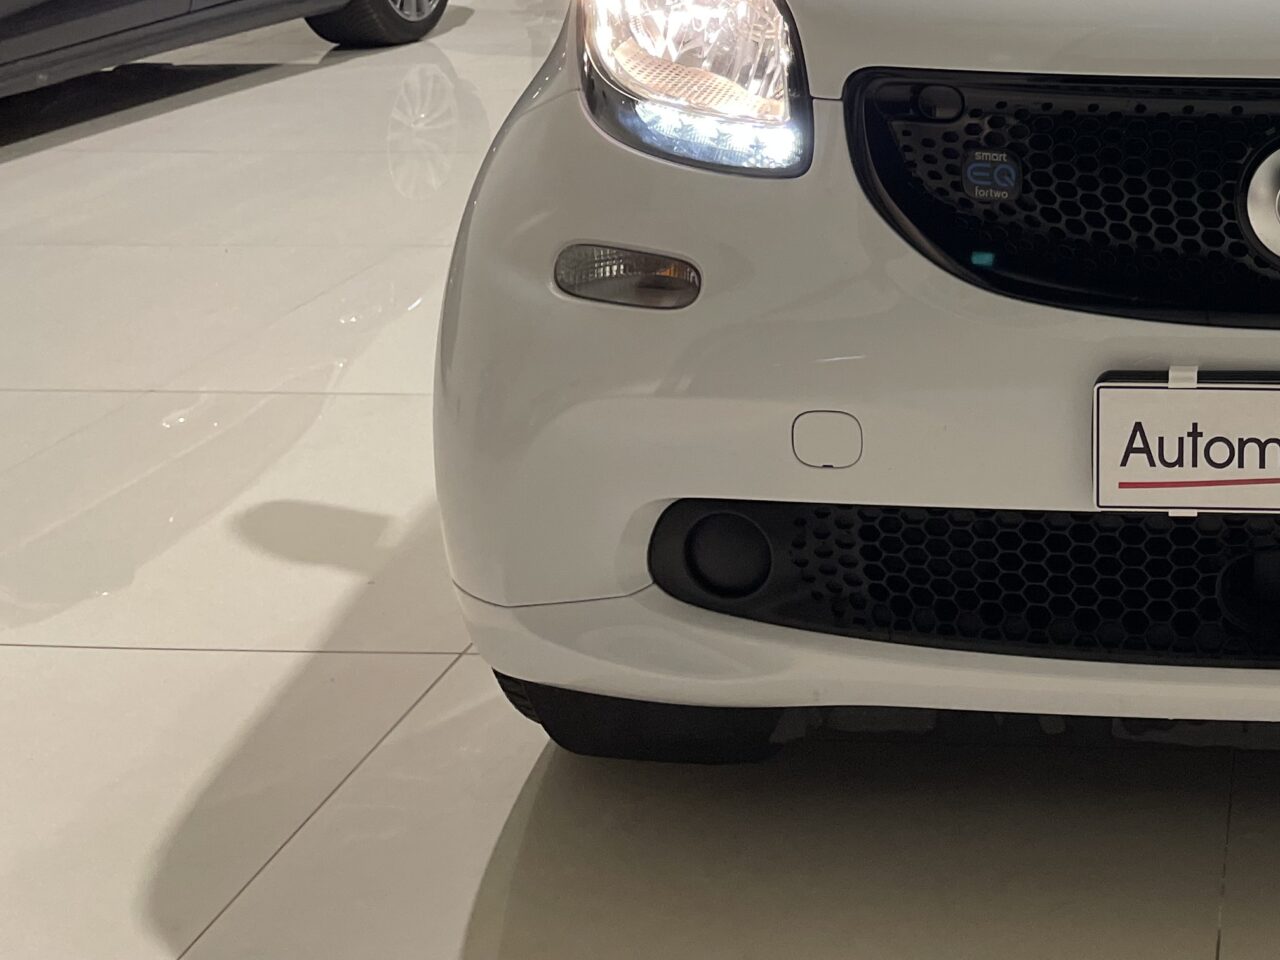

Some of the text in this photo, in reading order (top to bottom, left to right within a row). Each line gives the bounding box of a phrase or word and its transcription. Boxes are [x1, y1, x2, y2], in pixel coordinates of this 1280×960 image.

[975, 151, 1007, 162] smart
[966, 162, 1017, 187] EQ
[974, 186, 1009, 199] fortwo
